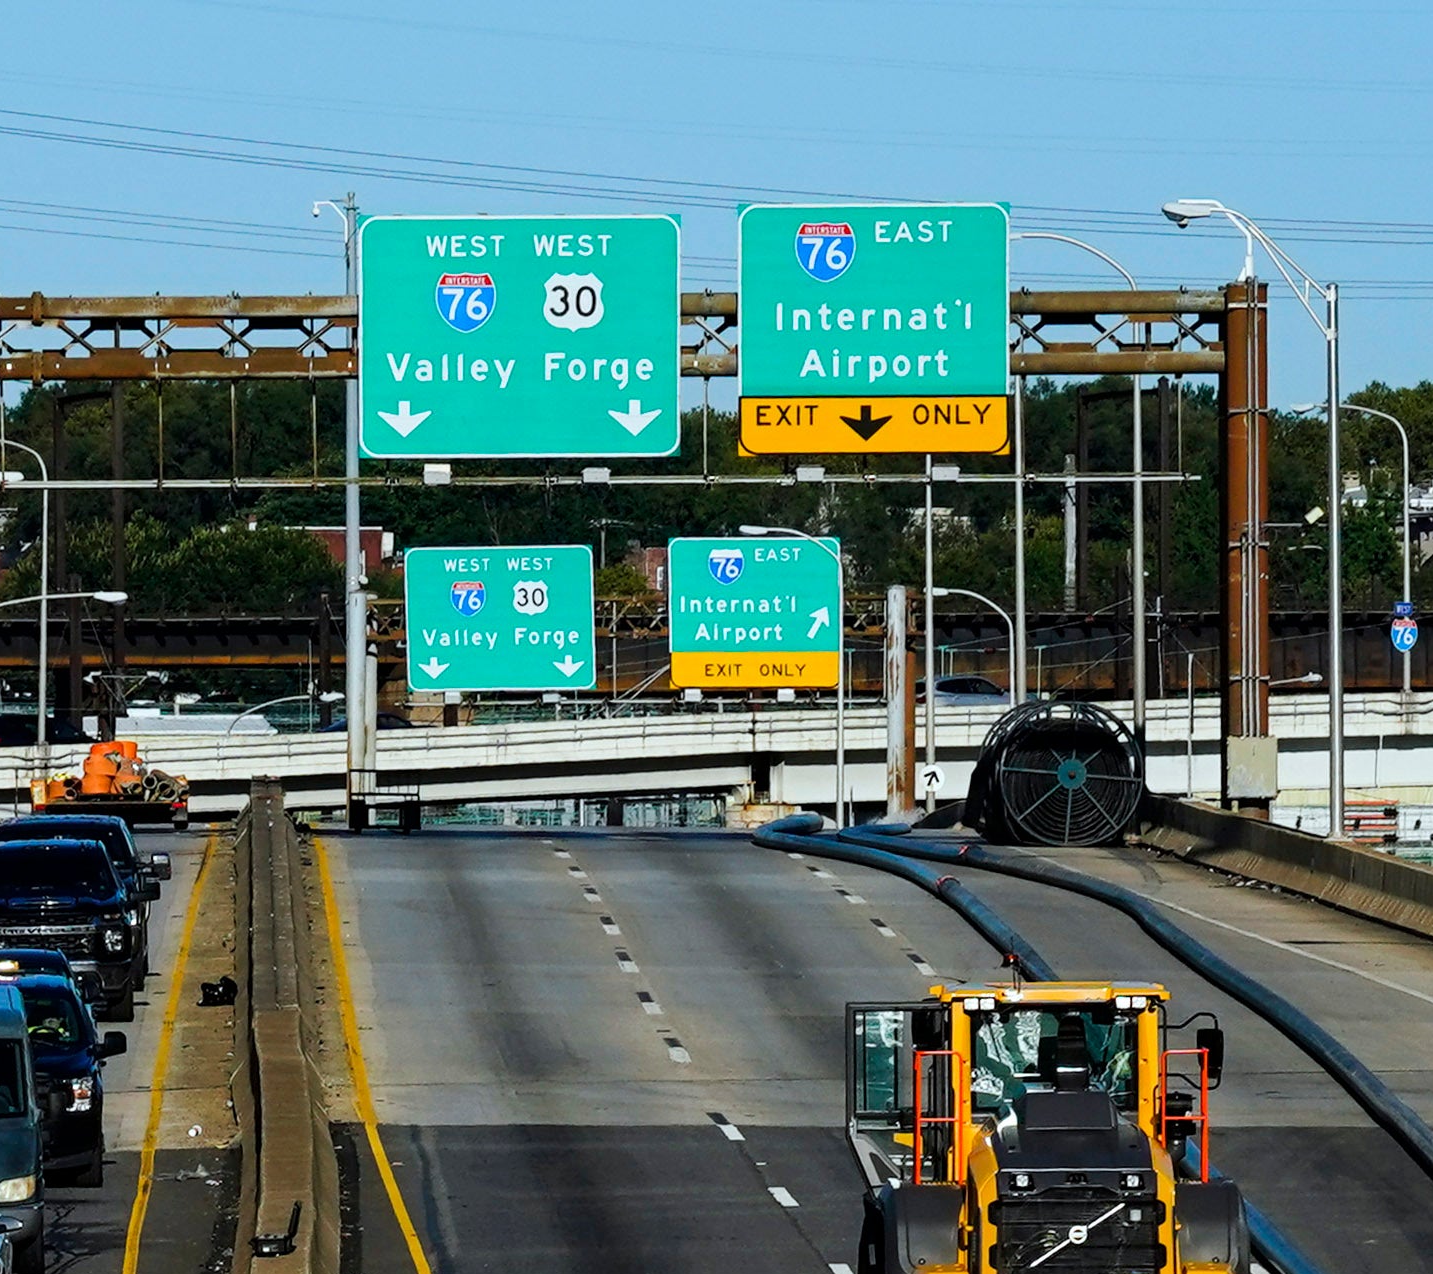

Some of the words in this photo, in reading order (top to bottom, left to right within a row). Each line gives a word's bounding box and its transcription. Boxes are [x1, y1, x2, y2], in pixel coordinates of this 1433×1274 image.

[804, 225, 845, 235] INTERSTATE
[874, 220, 953, 243] EAST
[426, 235, 505, 257] WEST
[533, 234, 612, 256] WEST
[801, 237, 847, 270] 76
[444, 276, 486, 286] INTERSTATE
[442, 288, 487, 321] 76
[549, 285, 597, 317] 30
[775, 299, 972, 331] Internat'l
[386, 352, 516, 389] Valley
[544, 352, 655, 390] Forge
[799, 349, 950, 384] Airport
[756, 405, 819, 426] EXIT
[912, 403, 992, 425] ONLY
[444, 558, 490, 572] WEST
[506, 557, 553, 571] WEST
[754, 547, 802, 562] EAST
[712, 558, 739, 578] 76
[454, 590, 482, 610] 76
[516, 587, 545, 607] 30
[679, 595, 796, 613] Internat'l
[422, 628, 498, 650] Valley
[514, 627, 580, 650] Forge
[694, 622, 783, 645] Airport
[1394, 627, 1414, 645] 76
[705, 663, 743, 677] EXIT
[759, 663, 807, 677] ONLY
